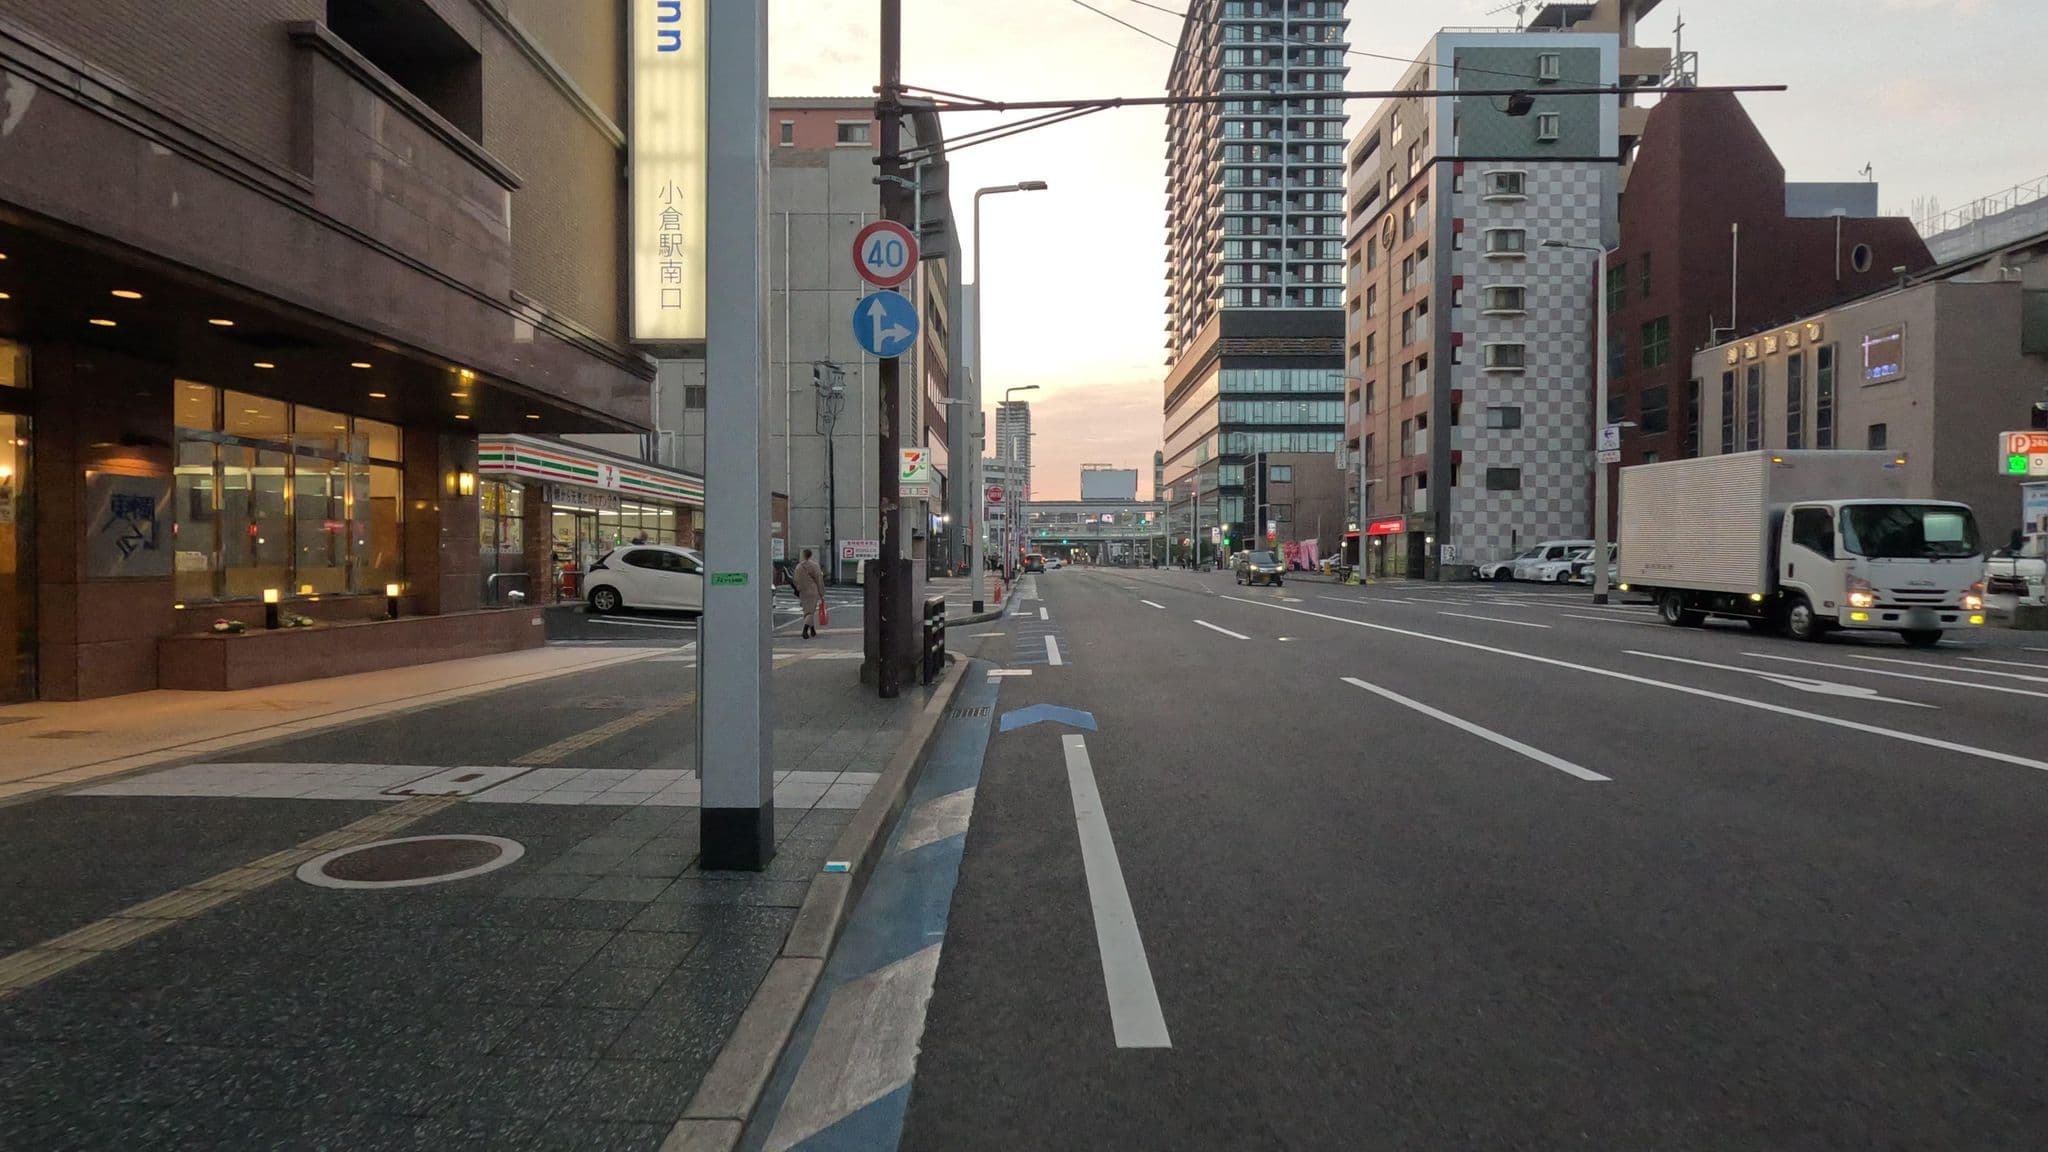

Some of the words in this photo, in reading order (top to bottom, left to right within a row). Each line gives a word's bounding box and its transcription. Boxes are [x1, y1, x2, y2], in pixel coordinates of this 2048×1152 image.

[658, 179, 684, 309] 小倉駅南口
[867, 239, 903, 268] 40
[2010, 434, 2031, 453] P
